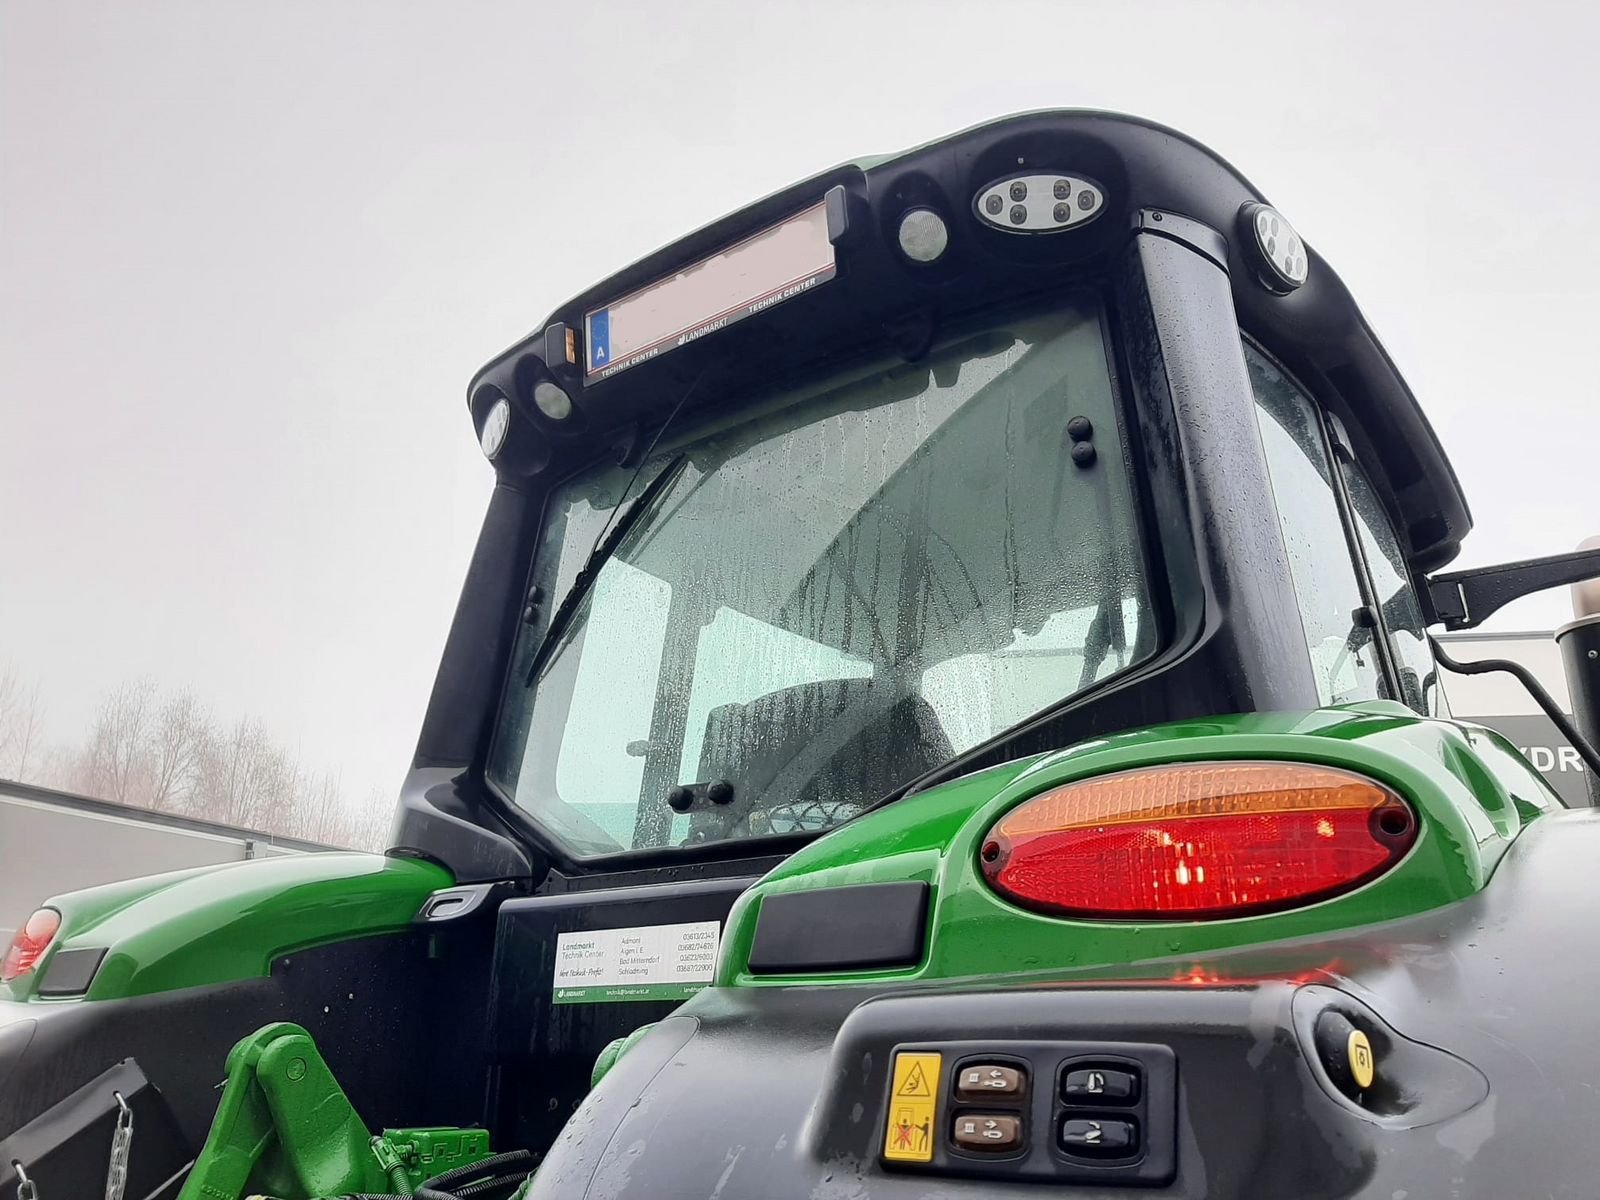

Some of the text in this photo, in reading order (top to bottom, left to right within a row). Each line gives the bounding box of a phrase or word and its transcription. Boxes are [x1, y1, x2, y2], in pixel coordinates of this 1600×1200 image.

[749, 277, 816, 313] TECHNIK CENTER
[685, 317, 728, 343] LANDMARKT
[596, 346, 605, 360] A
[601, 348, 659, 378] TECHNIK CENTER
[562, 941, 595, 951] Landmarkt
[562, 950, 604, 960] Technik Center
